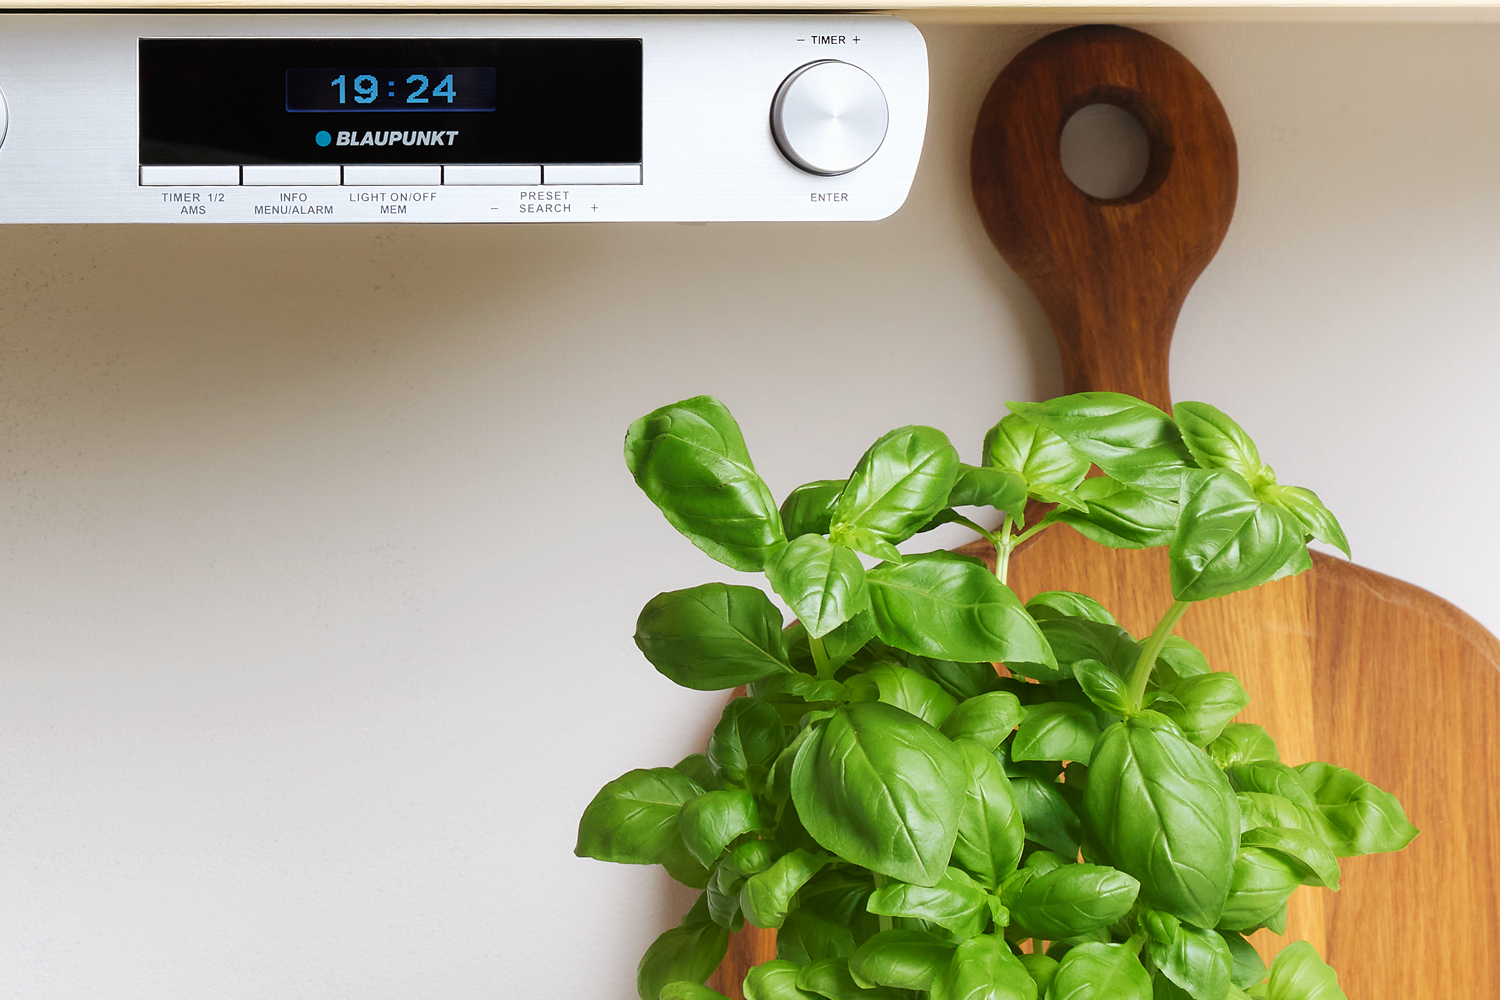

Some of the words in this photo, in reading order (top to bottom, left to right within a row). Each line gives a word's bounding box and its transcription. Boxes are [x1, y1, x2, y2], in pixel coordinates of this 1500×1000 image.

[810, 35, 846, 45] TIMER
[335, 130, 459, 146] BLAUPUNKT
[161, 192, 201, 203] TIMER
[207, 192, 225, 203] 1/2
[279, 192, 308, 203] INFO
[349, 192, 387, 203] LIGHT
[390, 192, 437, 202] ON/OFF
[520, 190, 570, 201] PRESET
[810, 192, 849, 203] ENTER
[180, 205, 207, 215] AMS
[254, 205, 334, 215] MENU/ALARM
[380, 204, 407, 215] MEM
[519, 203, 571, 214] SEARCH
